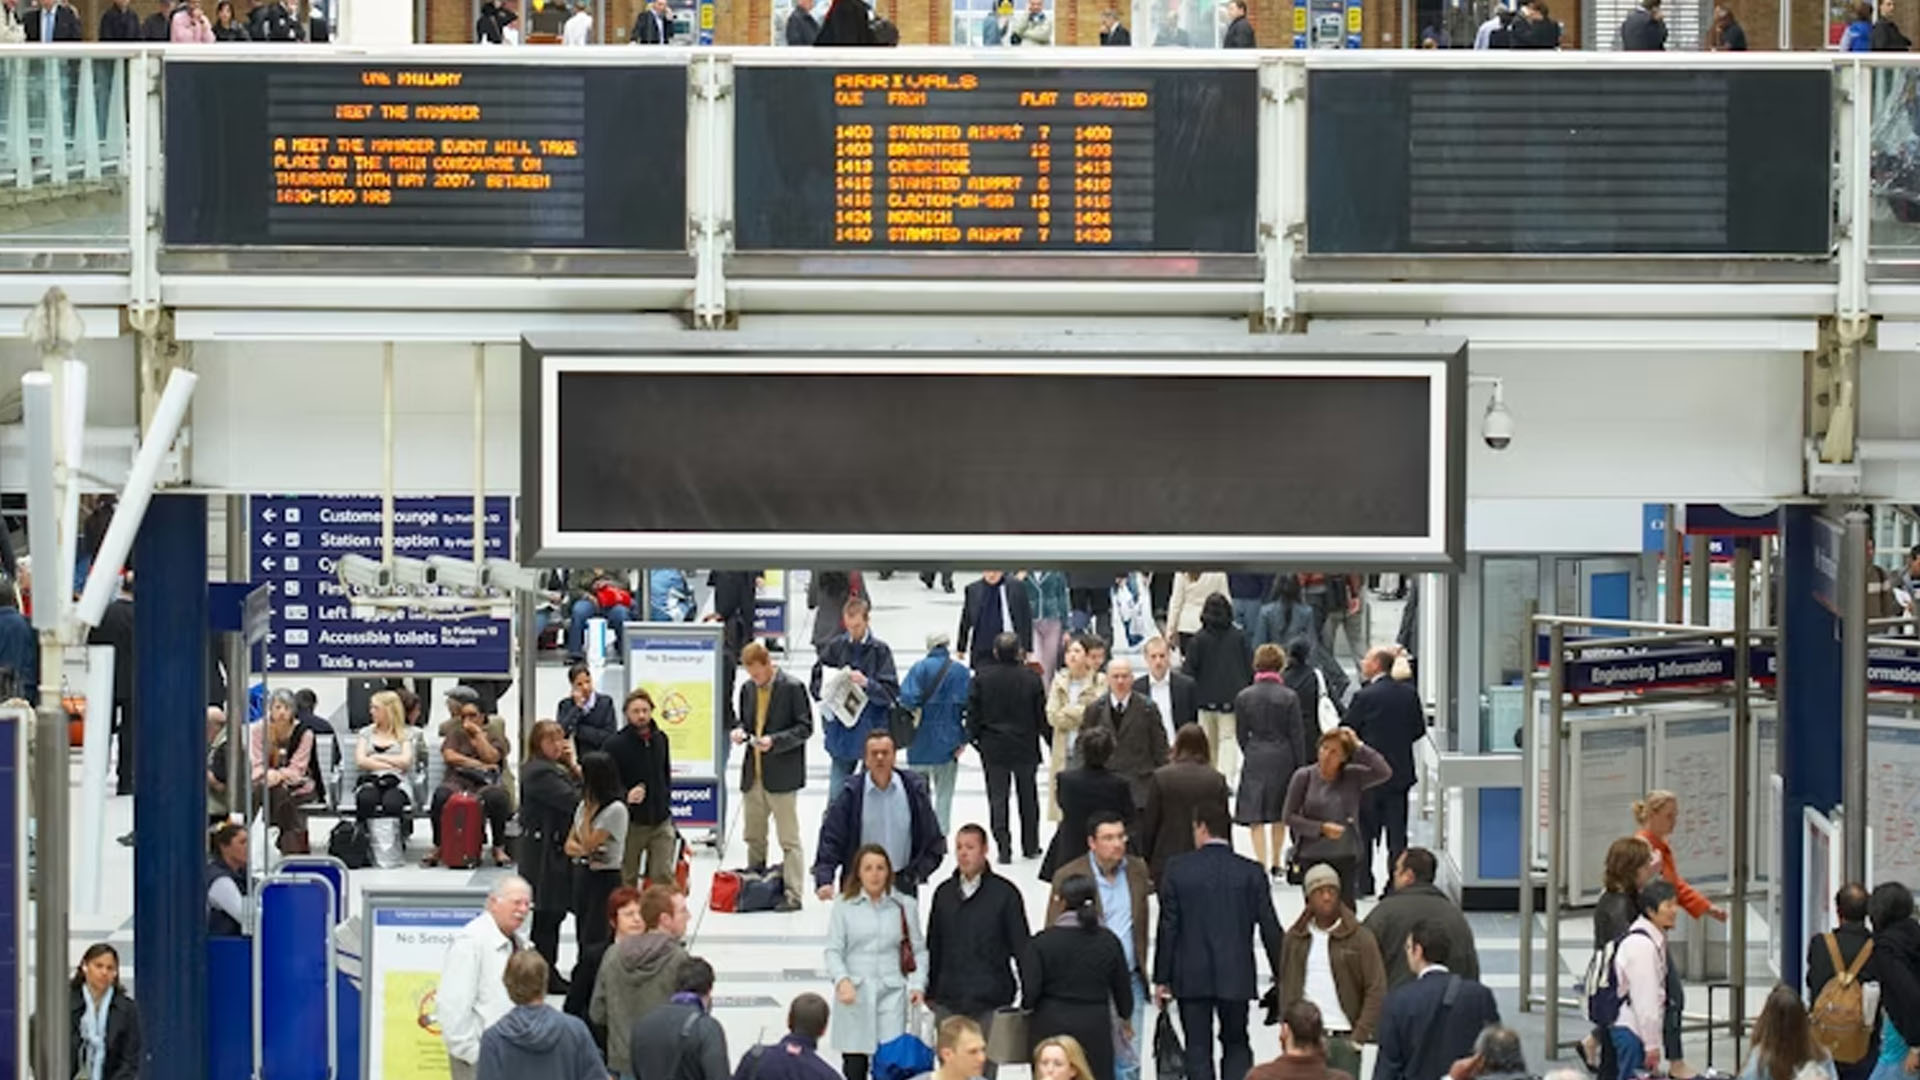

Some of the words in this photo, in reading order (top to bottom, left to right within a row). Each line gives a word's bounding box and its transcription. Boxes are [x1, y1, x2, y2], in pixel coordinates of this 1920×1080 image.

[835, 74, 978, 89] ARRIVALS
[835, 91, 862, 105] DUE
[888, 91, 926, 106] FROM
[1020, 92, 1057, 106] PLAT
[1074, 92, 1147, 107] EXPECTED
[381, 105, 408, 119] THE
[415, 106, 480, 120] MANAGER
[836, 125, 873, 140] 1400
[888, 125, 962, 140] STANSTED
[967, 125, 1022, 140] AIRPRT
[1039, 126, 1050, 140] 7
[1075, 126, 1112, 140] 1400
[274, 138, 286, 151] A
[292, 138, 328, 153] MEET
[338, 139, 364, 153] THE
[371, 139, 435, 153] MANAGER
[441, 139, 488, 154] EVENT
[494, 140, 531, 155] WILL
[540, 140, 576, 155] TAKE
[836, 141, 872, 156] 1403
[888, 141, 969, 157] BRAINTREE
[1031, 143, 1050, 157] 12
[1075, 143, 1112, 157] 1403
[275, 154, 320, 169] PLACE
[328, 156, 347, 169] ON
[354, 156, 381, 170] THE
[389, 156, 426, 170] MAIN
[433, 156, 515, 171] CONCOURSE
[521, 157, 542, 171] ON
[836, 159, 873, 174] 1413
[888, 159, 970, 174] CAMBRIDGE
[1075, 160, 1112, 174] 1413
[276, 172, 346, 186] THURSDAY
[356, 172, 391, 187] 10TH
[397, 173, 426, 186] MAY
[486, 174, 550, 188] BETWEEN
[888, 176, 962, 191] STANSTED
[967, 176, 1022, 191] AIRPRT
[363, 190, 391, 203] HRS
[887, 193, 1014, 208] CLACTON-ON-SEA
[1031, 194, 1050, 209] 13
[836, 210, 872, 225] 1424
[887, 210, 952, 225] NORWICH
[1075, 210, 1111, 225] 1424
[888, 226, 961, 242] STANSTED
[967, 227, 1023, 242] AIRPRT
[1039, 228, 1049, 241] 7
[320, 508, 384, 523] Custome
[393, 508, 438, 527] ounge
[320, 533, 371, 547] Station
[319, 605, 347, 620] Left
[318, 630, 391, 645] Accessible
[394, 630, 438, 645] toilets
[318, 654, 354, 669] Taxis
[357, 659, 368, 670] By
[369, 659, 403, 669] Platform
[404, 659, 414, 669] 10
[1592, 665, 1656, 685] Engineering
[1658, 661, 1722, 678] Information
[671, 787, 712, 803] erpool
[397, 933, 414, 944] No
